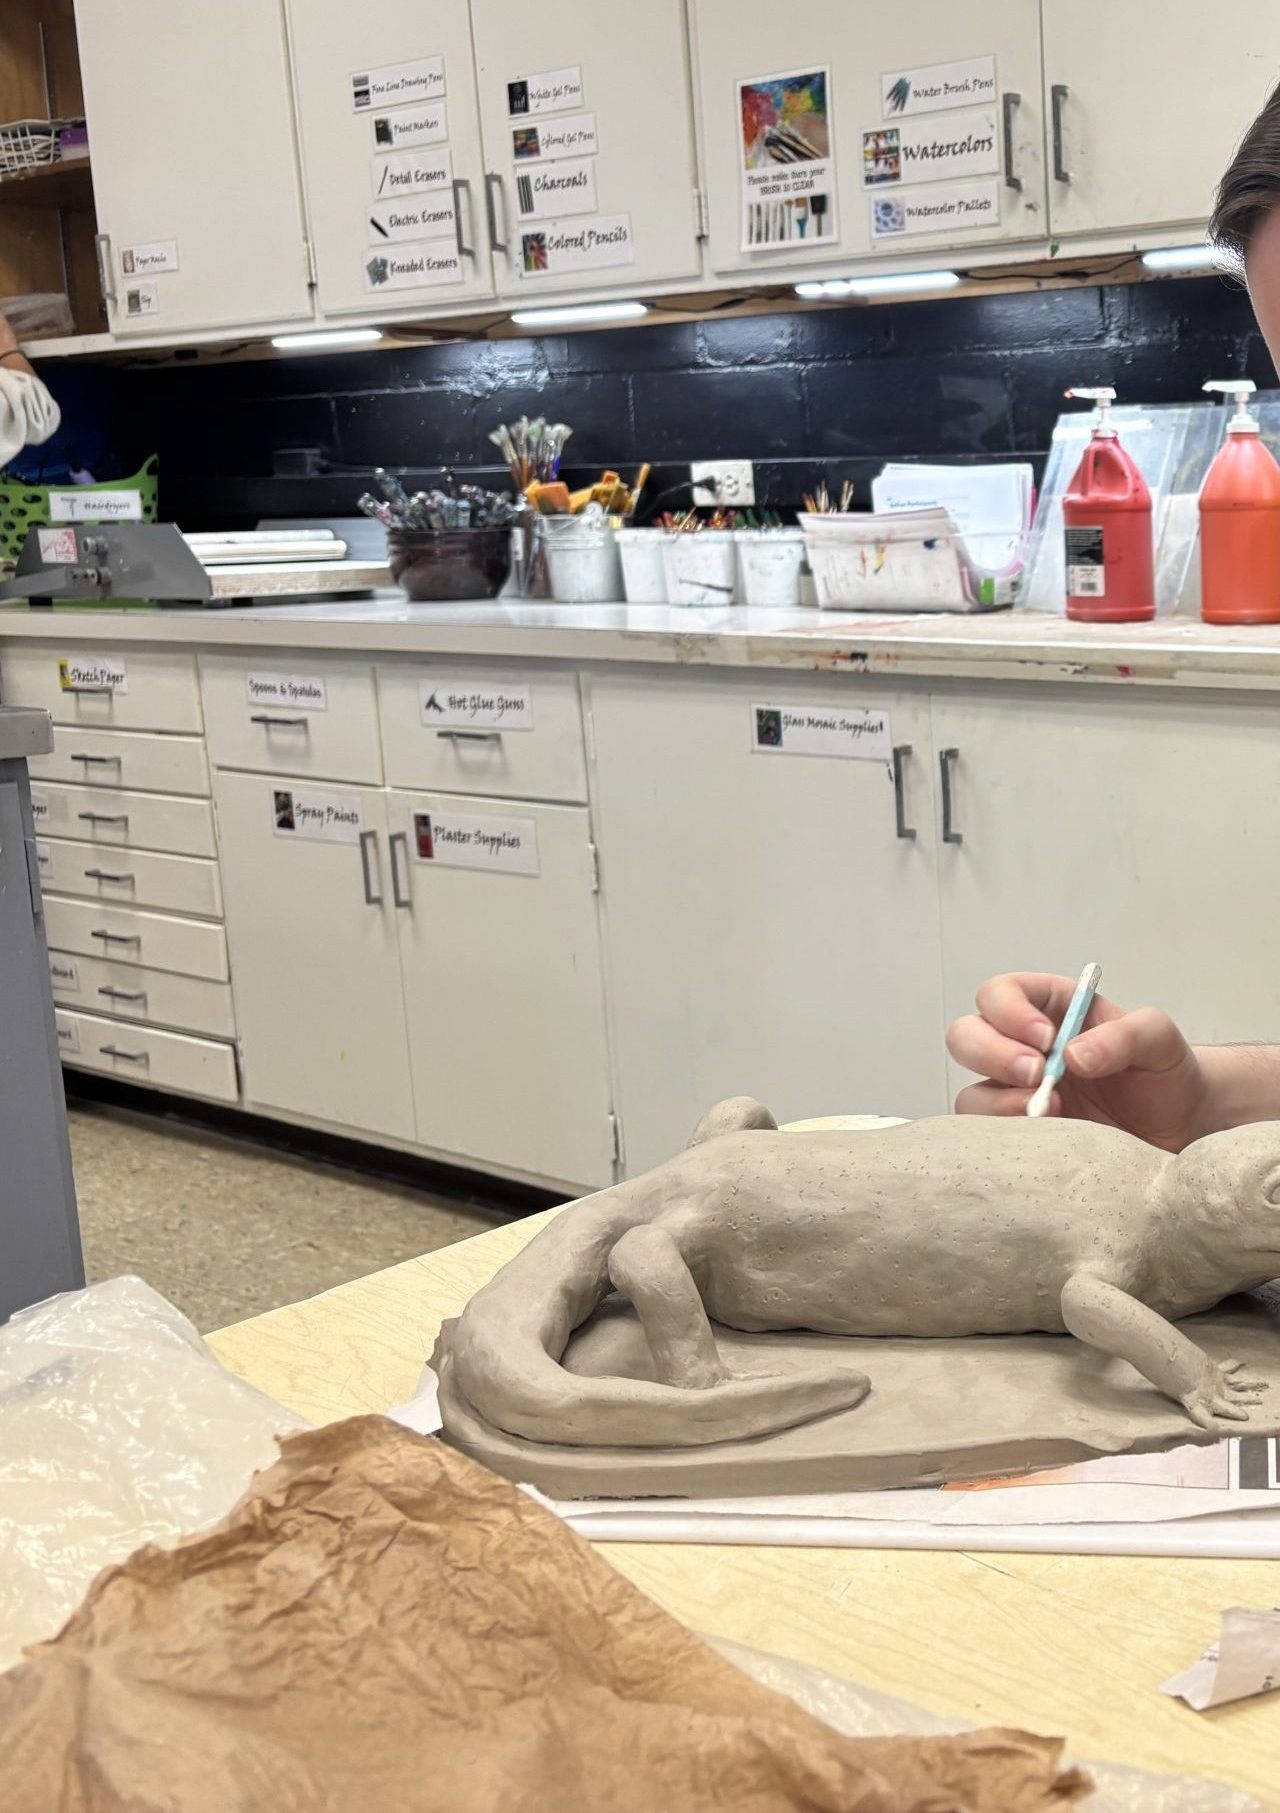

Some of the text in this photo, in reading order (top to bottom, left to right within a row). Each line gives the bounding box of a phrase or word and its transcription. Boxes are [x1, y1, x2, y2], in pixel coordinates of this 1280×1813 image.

[913, 77, 993, 98] Water Brush Pens
[902, 134, 993, 161] Watercolors
[389, 169, 447, 186] Detail Erasers
[534, 171, 588, 192] Charcoals
[906, 198, 992, 217] Watercolor Pallets
[388, 209, 454, 228] Electric Erasers
[547, 225, 628, 251] Colored Pencils
[426, 258, 459, 271] Erasers
[70, 667, 100, 683] Sketch
[447, 693, 525, 718] Hot Glue Guns
[783, 714, 805, 731] Glass
[806, 717, 837, 731] Mosaic
[295, 802, 360, 829] Spray Paints
[433, 825, 522, 857] Plaster Supplies
